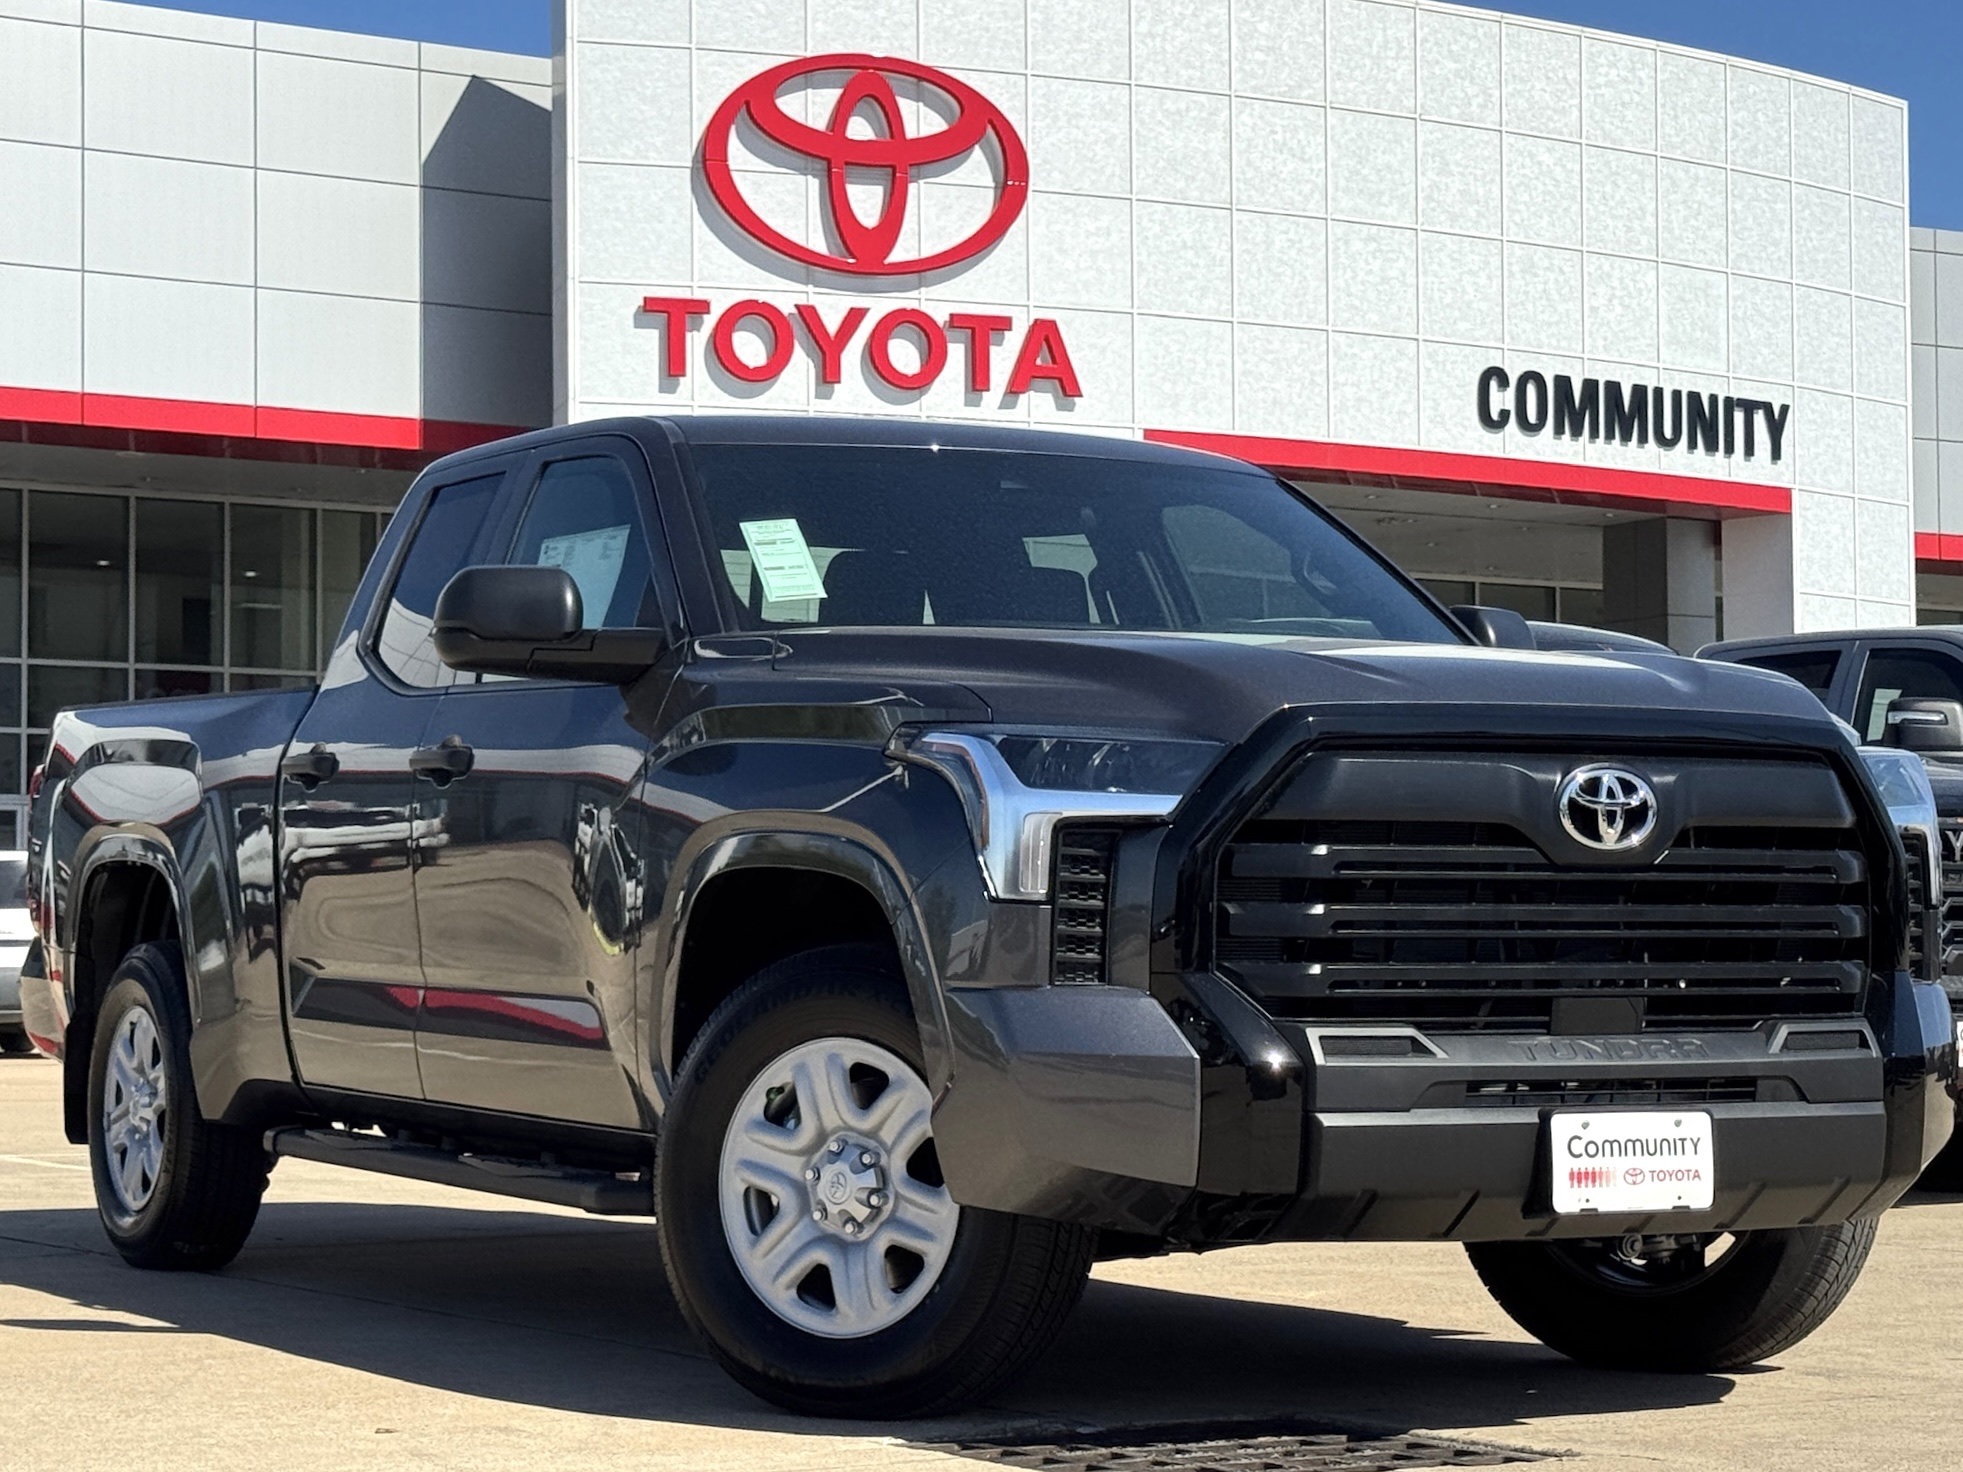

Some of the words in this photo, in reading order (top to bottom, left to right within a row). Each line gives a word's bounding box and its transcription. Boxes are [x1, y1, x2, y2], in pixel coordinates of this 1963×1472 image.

[643, 296, 1083, 398] TOYOTA
[1477, 366, 1790, 461] COMMUNITY
[1506, 1038, 1710, 1060] TUNDRA
[1649, 1169, 1702, 1182] TOYOTA
